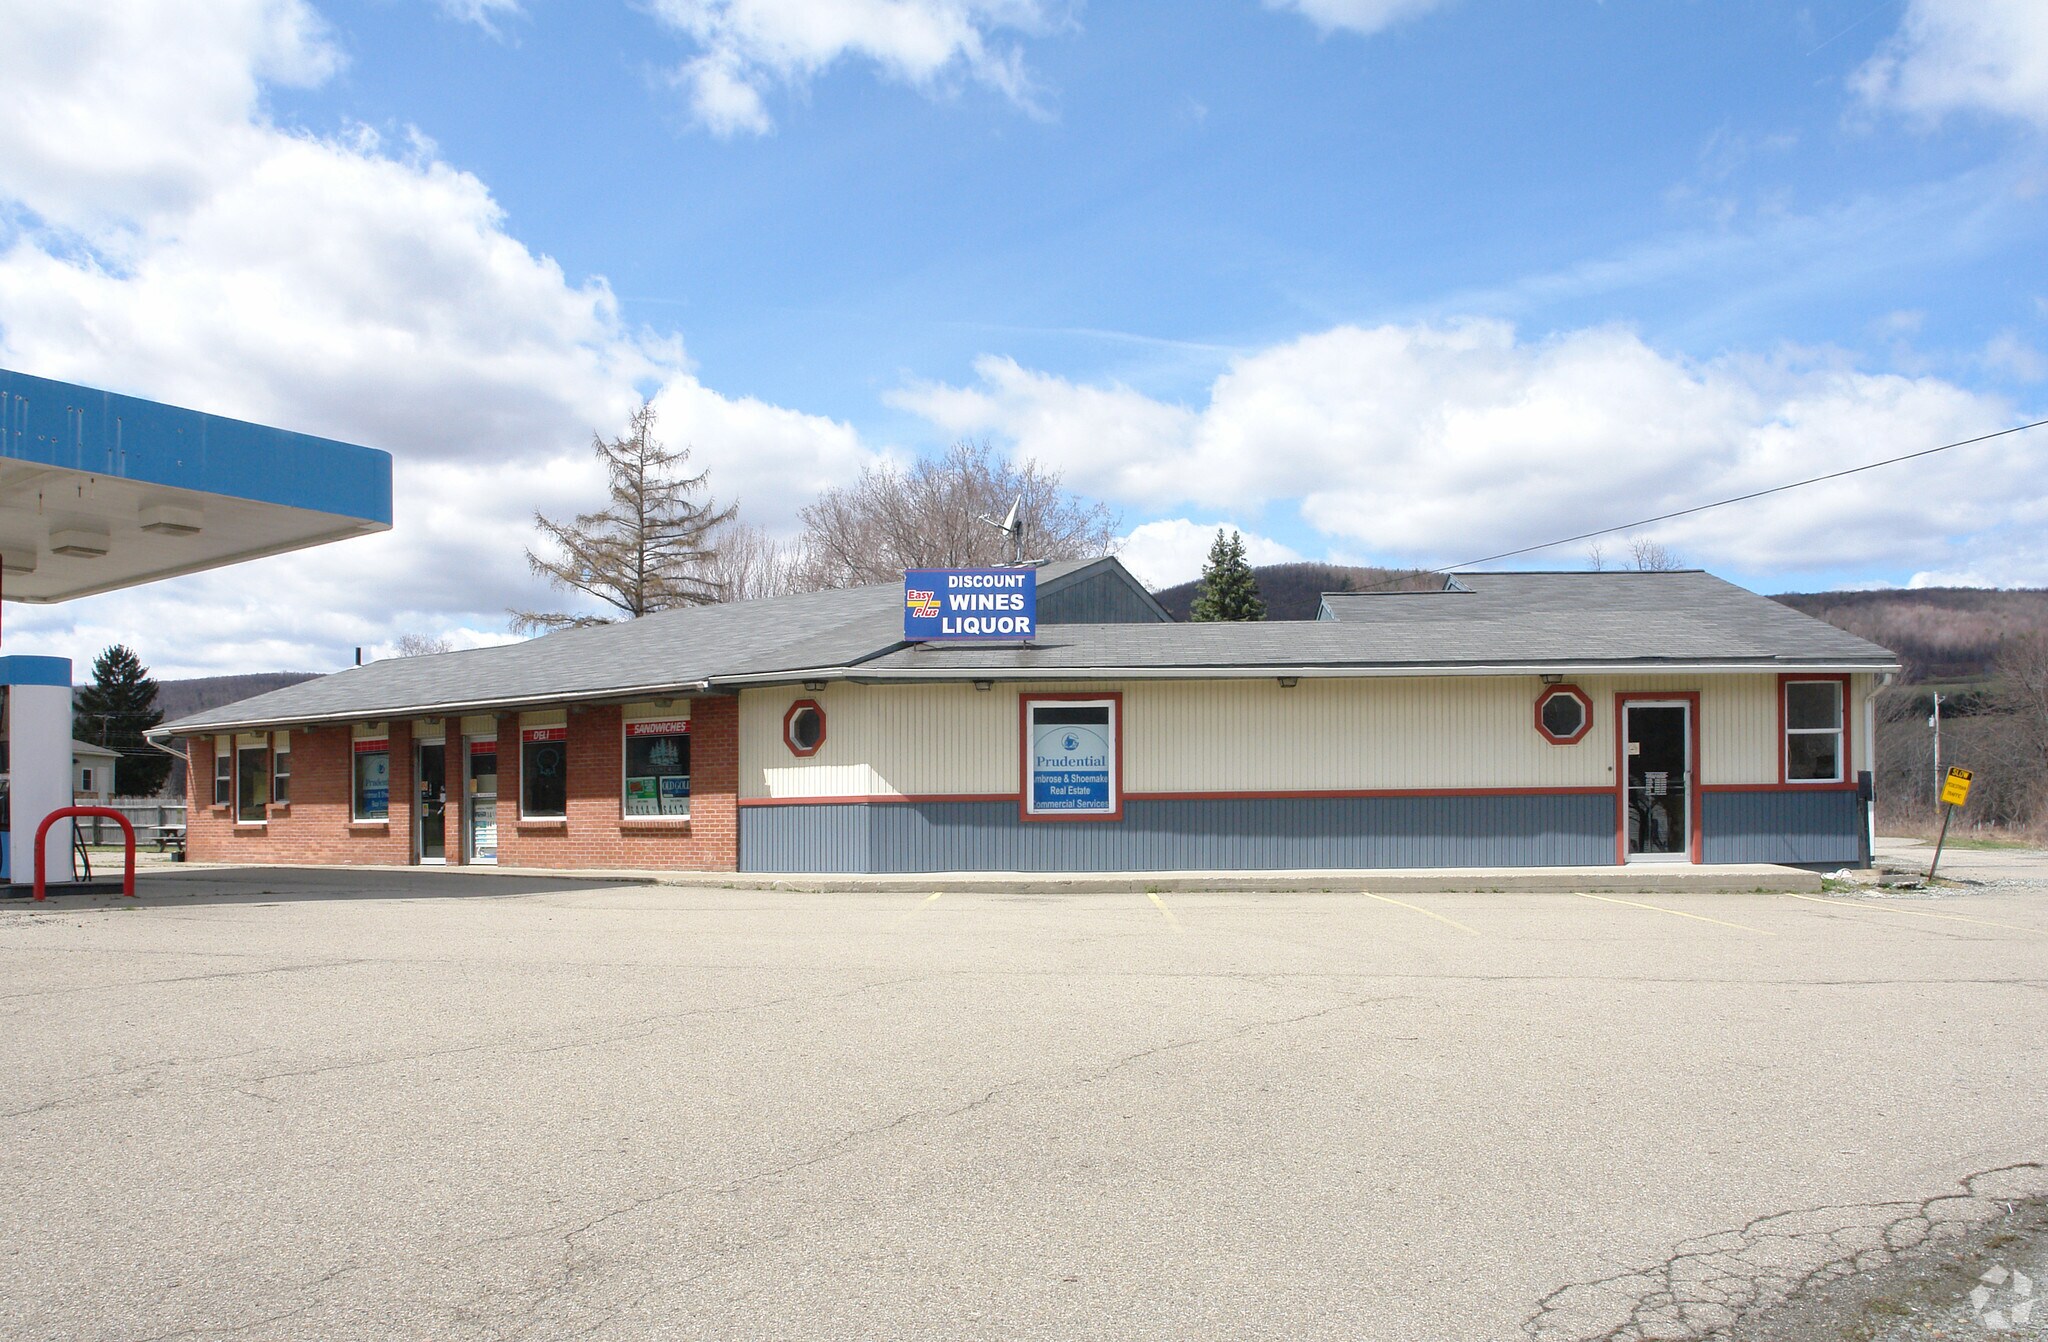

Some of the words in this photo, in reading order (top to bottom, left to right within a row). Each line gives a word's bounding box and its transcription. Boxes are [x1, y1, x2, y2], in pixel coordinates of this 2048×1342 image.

[948, 575, 1026, 588] DISCOUNT
[908, 590, 934, 601] Easy
[949, 594, 1025, 611] WINES
[913, 605, 939, 618] Plus
[942, 616, 1031, 635] LIQUOR
[634, 721, 687, 734] SANDWICHES
[533, 730, 550, 740] DELI
[1037, 755, 1106, 767] Prudential
[1063, 774, 1069, 783] &
[1951, 768, 1969, 778] SLOW
[1050, 785, 1067, 795] Real
[1068, 785, 1091, 795] Estate
